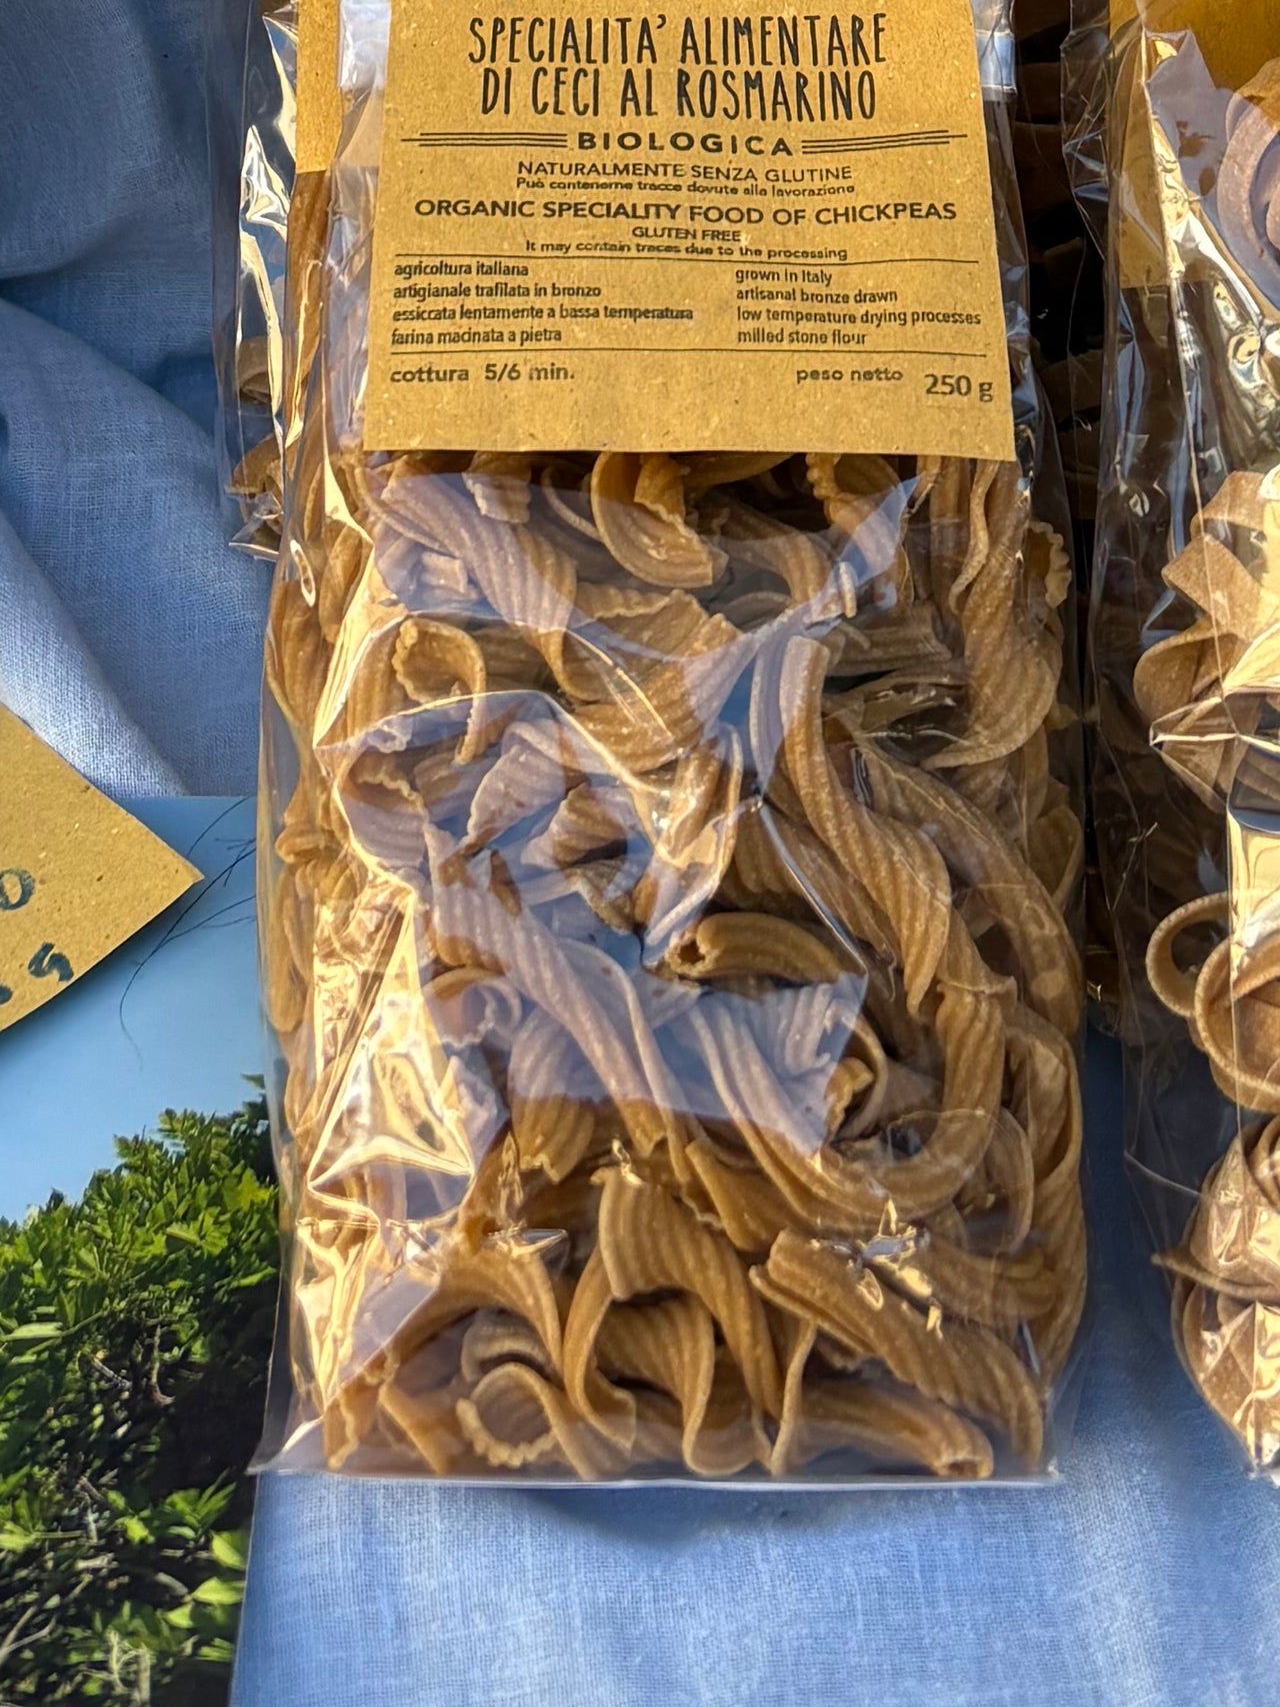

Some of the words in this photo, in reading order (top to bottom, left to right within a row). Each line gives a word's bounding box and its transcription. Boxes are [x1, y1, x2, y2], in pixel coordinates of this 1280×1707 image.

[468, 13, 667, 64] SPECIALITA'
[679, 12, 887, 67] ALIMENTARE
[481, 67, 512, 115] DI
[531, 66, 600, 117] CECI
[620, 67, 659, 117] AL
[676, 69, 877, 123] ROSMARINO
[577, 132, 793, 156] BIOLOGICA
[517, 161, 686, 178] NATURALMENTE
[691, 165, 758, 182] SENZA
[764, 165, 853, 183] GLUTINE
[414, 199, 535, 218] ORGANIC
[542, 201, 681, 220] SPECIALITY
[688, 206, 764, 225] FOOD
[773, 208, 807, 226] OF
[815, 202, 957, 226] CHICKPEAS
[632, 226, 697, 241] GLUTEN
[701, 229, 741, 243] FREE
[393, 260, 473, 280] agricoltura
[476, 261, 530, 277] italiana
[735, 269, 781, 283] grown
[784, 268, 799, 282] in
[801, 268, 832, 287] Italy
[393, 283, 471, 303] artigianale
[475, 282, 531, 298] trafilata
[533, 283, 548, 297] in
[551, 282, 602, 298] bronzo
[736, 287, 797, 302] artisanal
[800, 288, 850, 304] bronze
[853, 288, 898, 303] drawn
[392, 306, 457, 322] essiccata
[459, 304, 545, 321] lentamente
[547, 308, 556, 319] a
[559, 304, 600, 319] bassa
[603, 305, 694, 323] temperatura
[737, 306, 762, 321] low
[766, 307, 857, 325] temperature
[860, 310, 908, 327] drying
[911, 310, 982, 329] processes
[391, 328, 435, 346] farina
[437, 327, 505, 345] macinata
[507, 330, 517, 342] a
[519, 327, 563, 347] pietra
[737, 328, 785, 344] milled
[788, 330, 828, 345] stone
[831, 329, 867, 345] flour
[389, 365, 470, 384] cottura
[484, 363, 521, 383] 5/6
[527, 362, 576, 381] min.
[796, 367, 843, 384] peso
[850, 367, 904, 382] netto
[923, 373, 973, 397] 250
[978, 380, 994, 403] g
